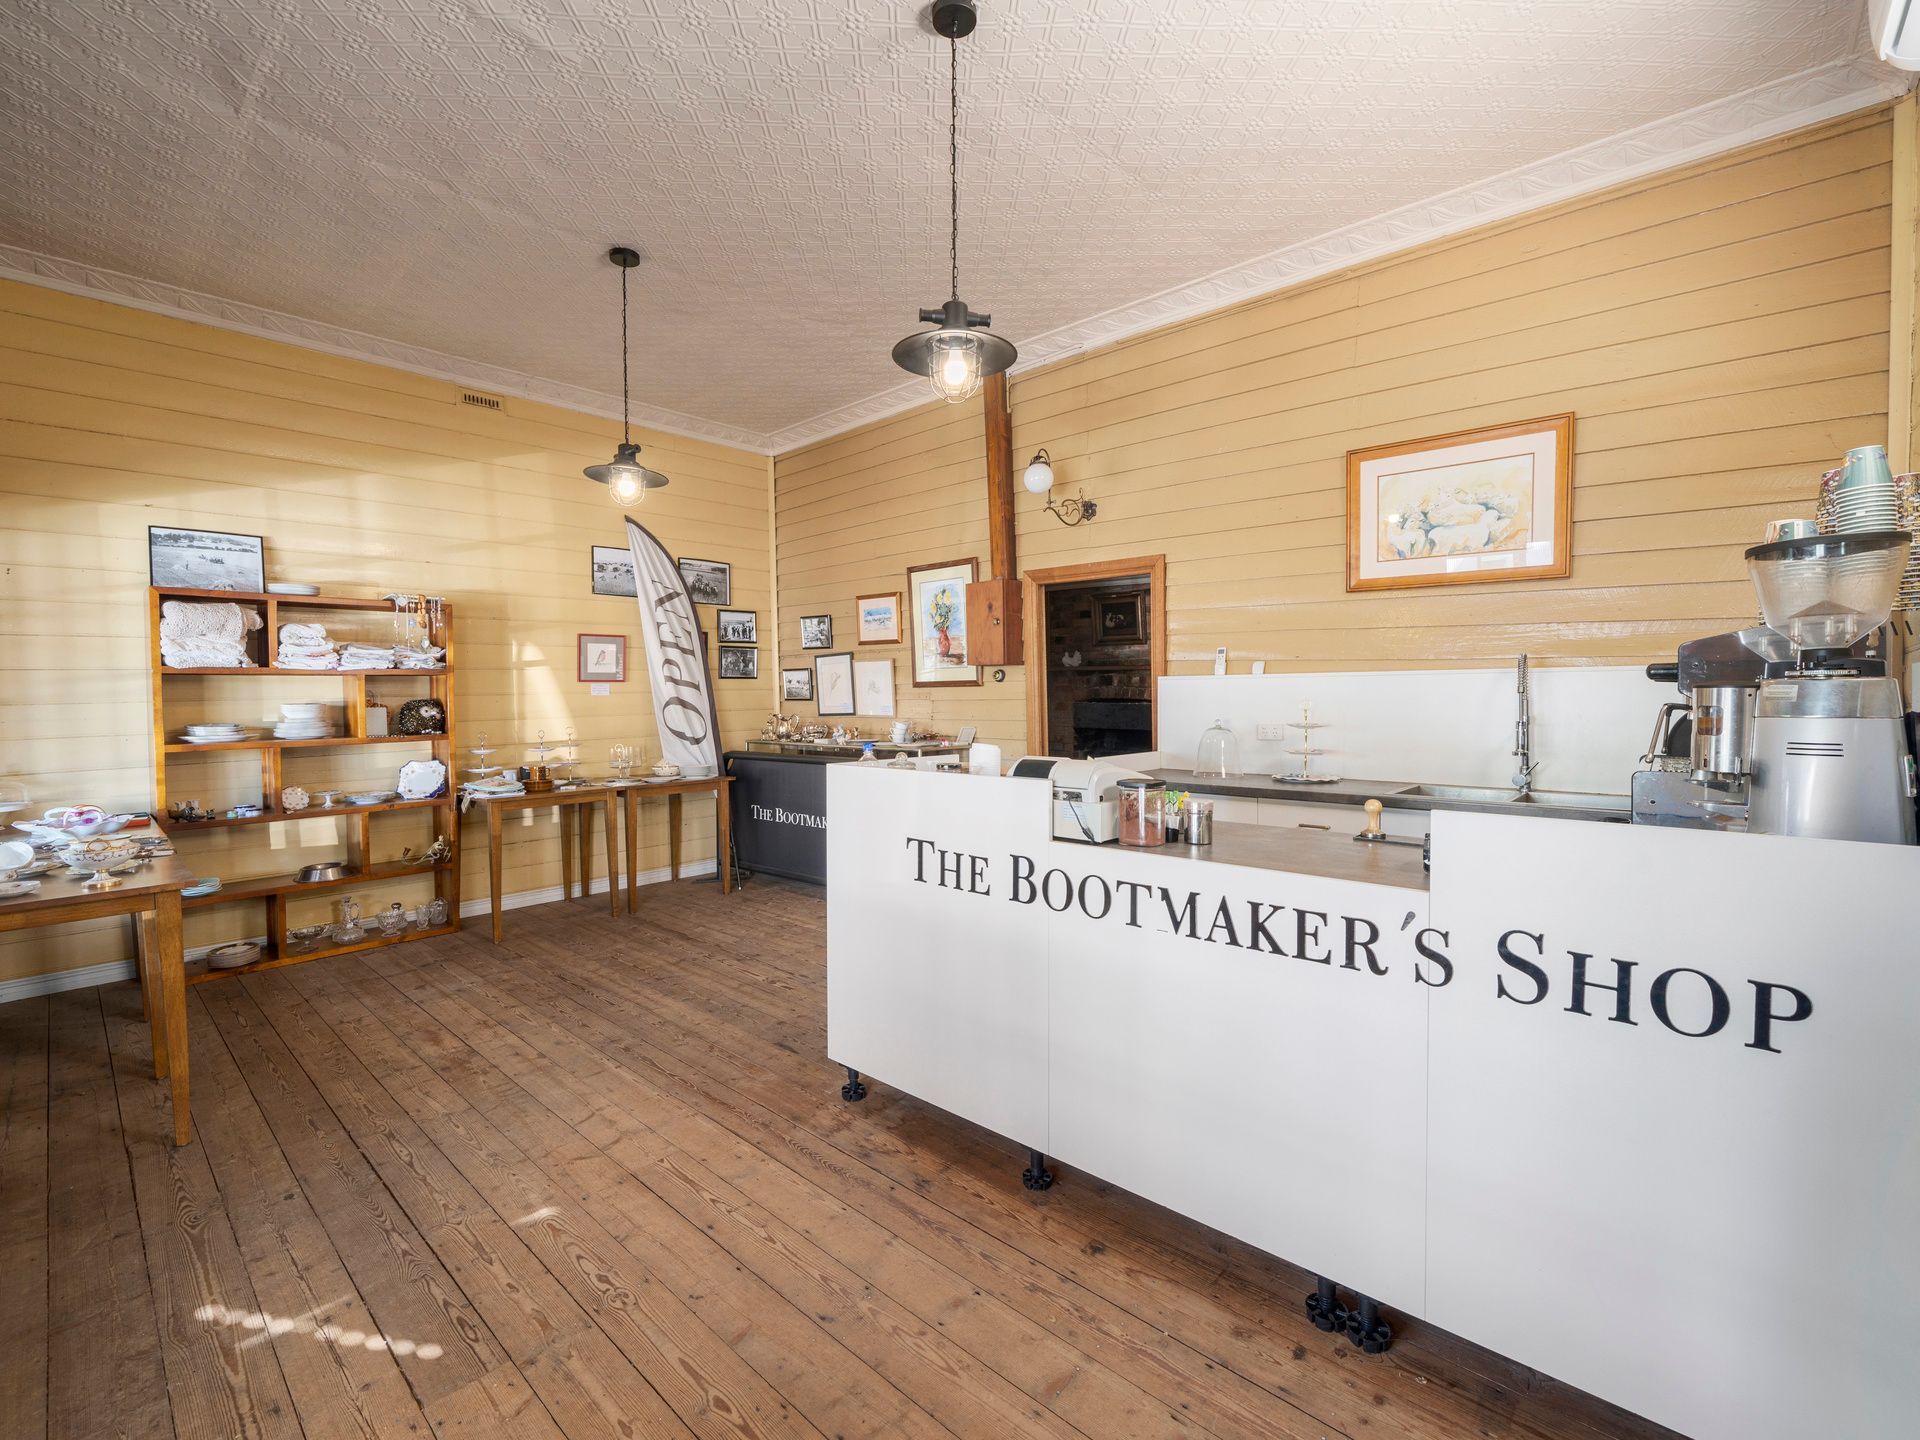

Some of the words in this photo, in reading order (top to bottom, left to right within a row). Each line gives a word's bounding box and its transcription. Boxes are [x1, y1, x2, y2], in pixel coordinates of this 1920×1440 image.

[651, 579, 708, 746] OPEN
[750, 804, 773, 822] THE
[906, 837, 991, 896] THE
[1497, 929, 1815, 1055] SHOP
